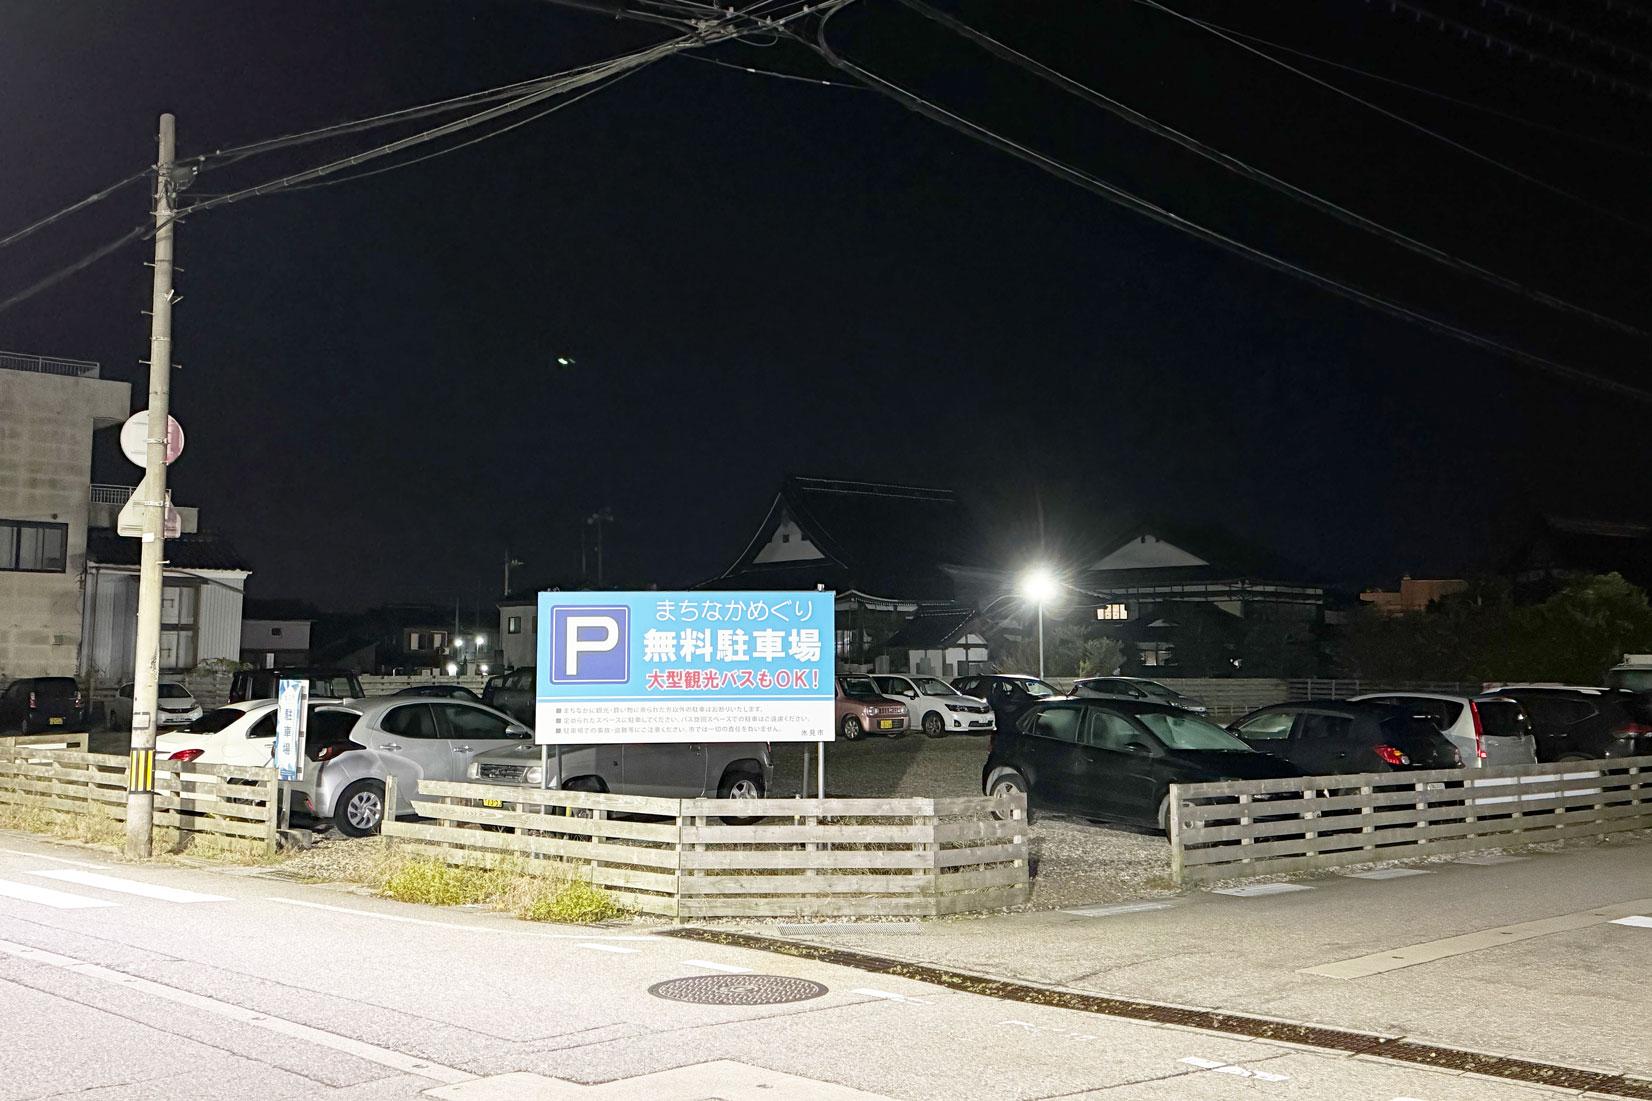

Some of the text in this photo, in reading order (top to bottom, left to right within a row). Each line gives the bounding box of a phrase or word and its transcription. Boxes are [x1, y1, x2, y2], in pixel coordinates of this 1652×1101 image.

[656, 600, 813, 622] まちなかめぐり
[565, 616, 619, 676] P
[643, 628, 822, 663] 無料駐車場
[646, 669, 820, 690] 大型観光バスもOK！
